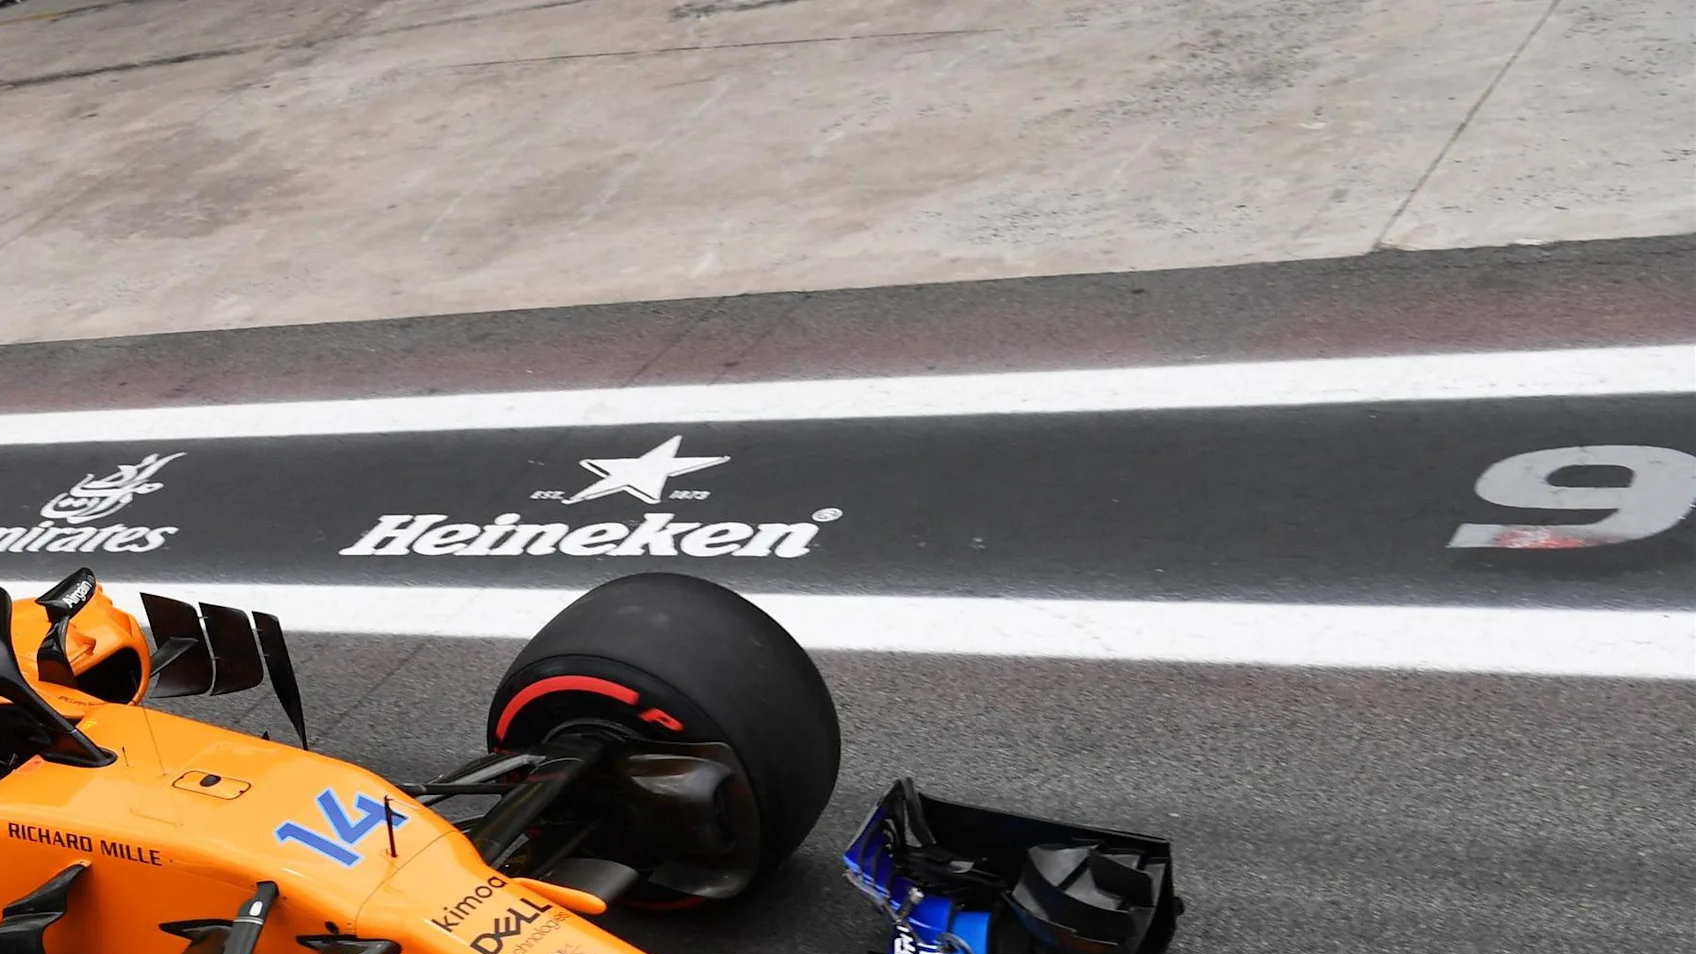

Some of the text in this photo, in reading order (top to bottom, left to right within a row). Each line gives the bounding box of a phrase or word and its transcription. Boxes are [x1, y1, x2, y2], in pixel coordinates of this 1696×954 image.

[338, 512, 821, 559] Heineken
[8, 822, 164, 867] RICHARD MILLE
[272, 786, 411, 870] 14
[430, 875, 508, 933] kimoa
